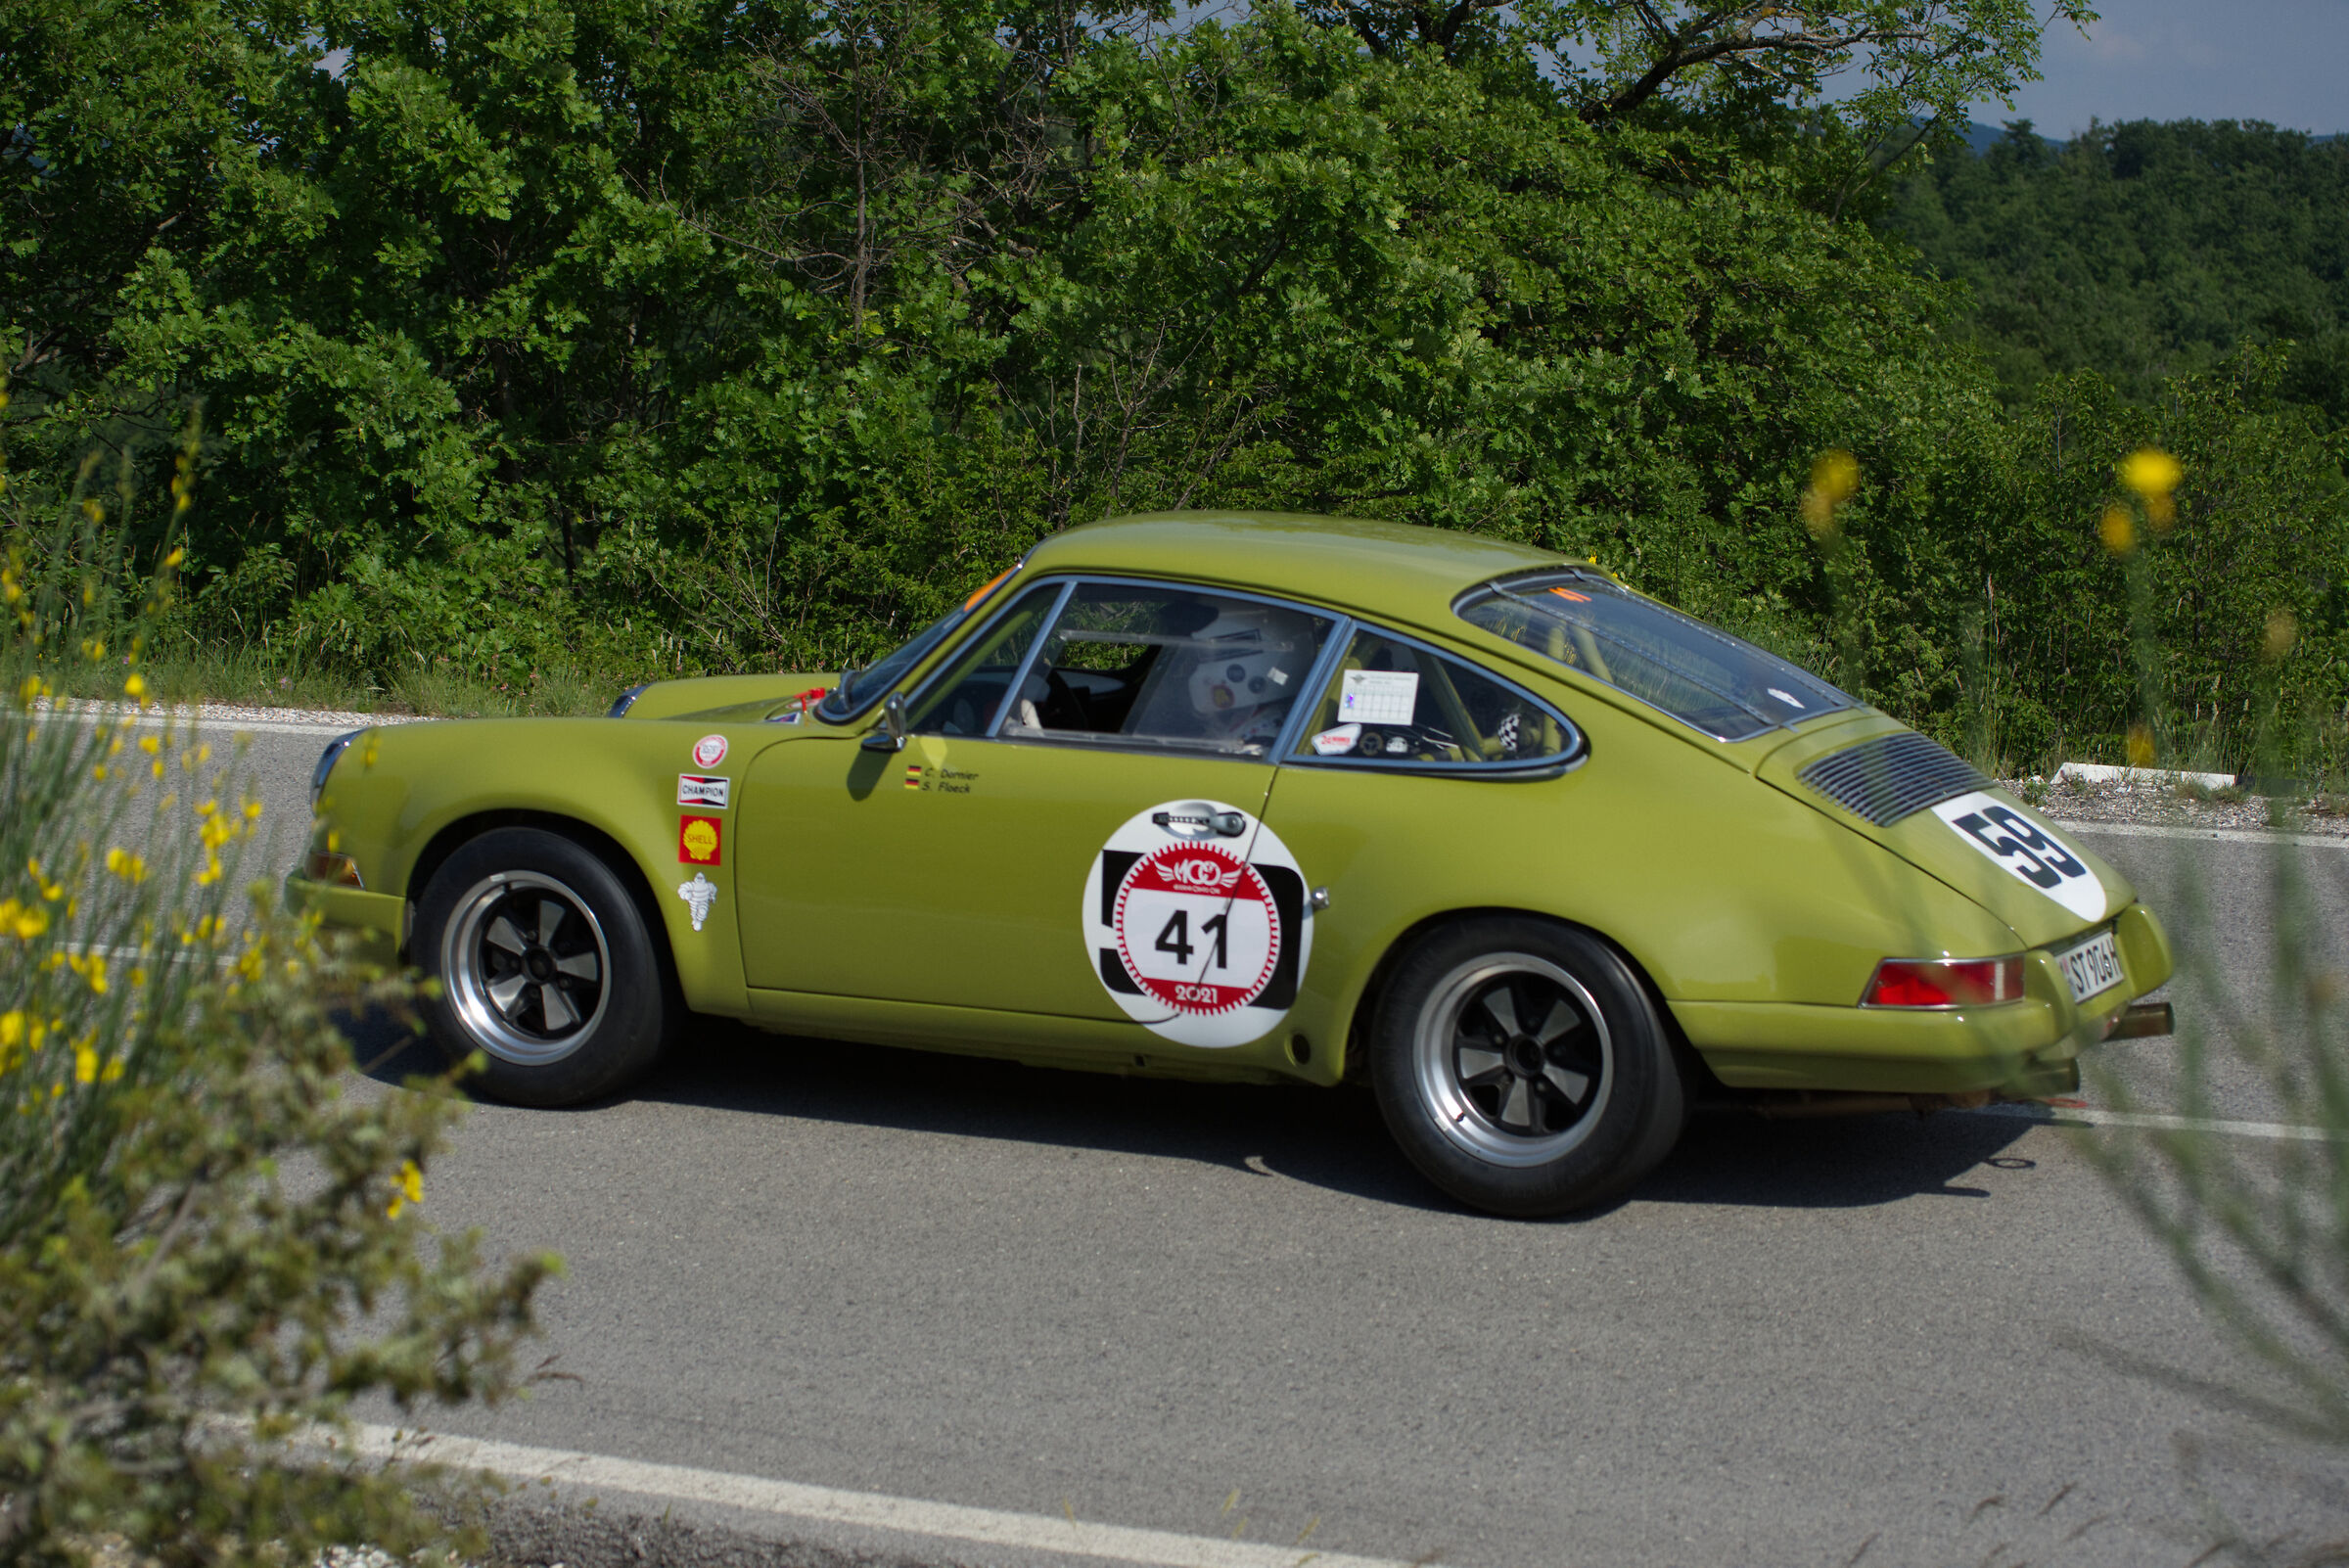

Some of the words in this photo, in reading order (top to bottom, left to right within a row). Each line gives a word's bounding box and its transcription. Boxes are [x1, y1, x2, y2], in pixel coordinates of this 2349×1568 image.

[681, 784, 724, 798] CHAMPION
[687, 834, 714, 845] SHELL
[1952, 806, 2087, 889] 59
[1155, 909, 1227, 970] 41
[1174, 985, 1218, 1004] 2021
